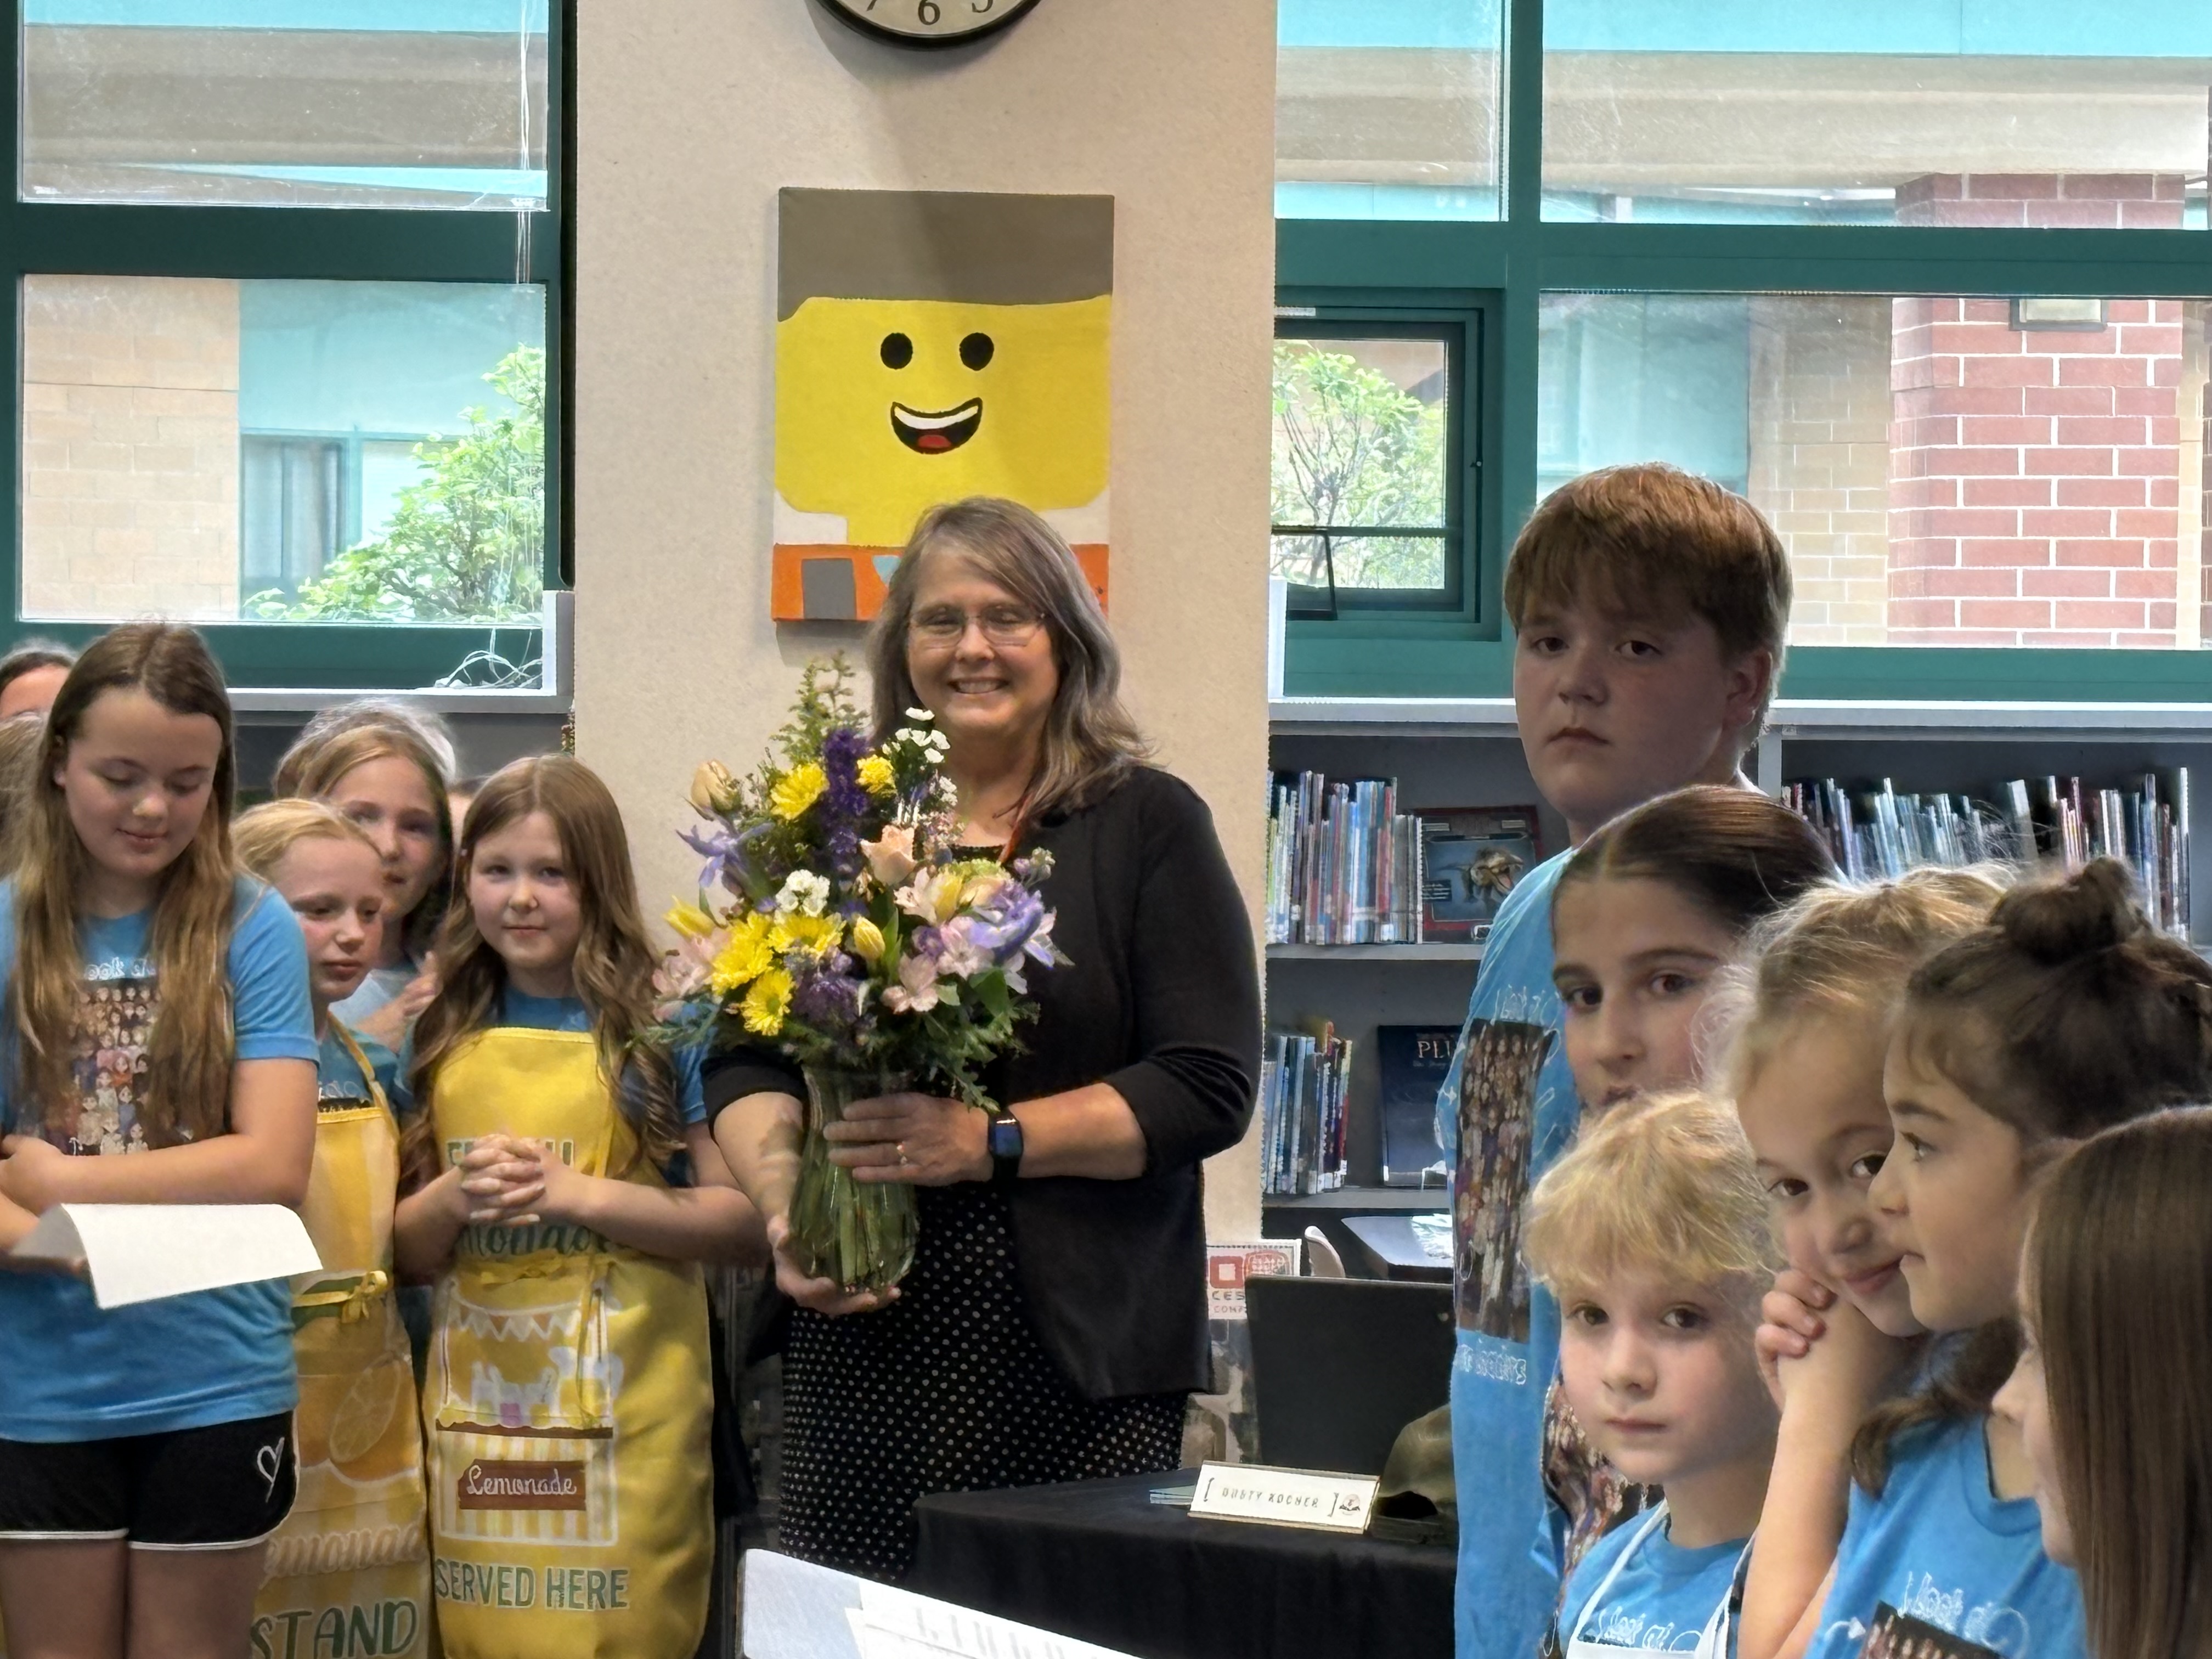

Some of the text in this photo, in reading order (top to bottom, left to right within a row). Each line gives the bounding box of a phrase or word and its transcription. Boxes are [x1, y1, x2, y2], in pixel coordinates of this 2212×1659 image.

[918, 0, 940, 25] 6
[466, 1464, 577, 1496] Lemonade
[434, 1558, 629, 1611] SERVED HERE
[250, 1599, 417, 1659] STAND
